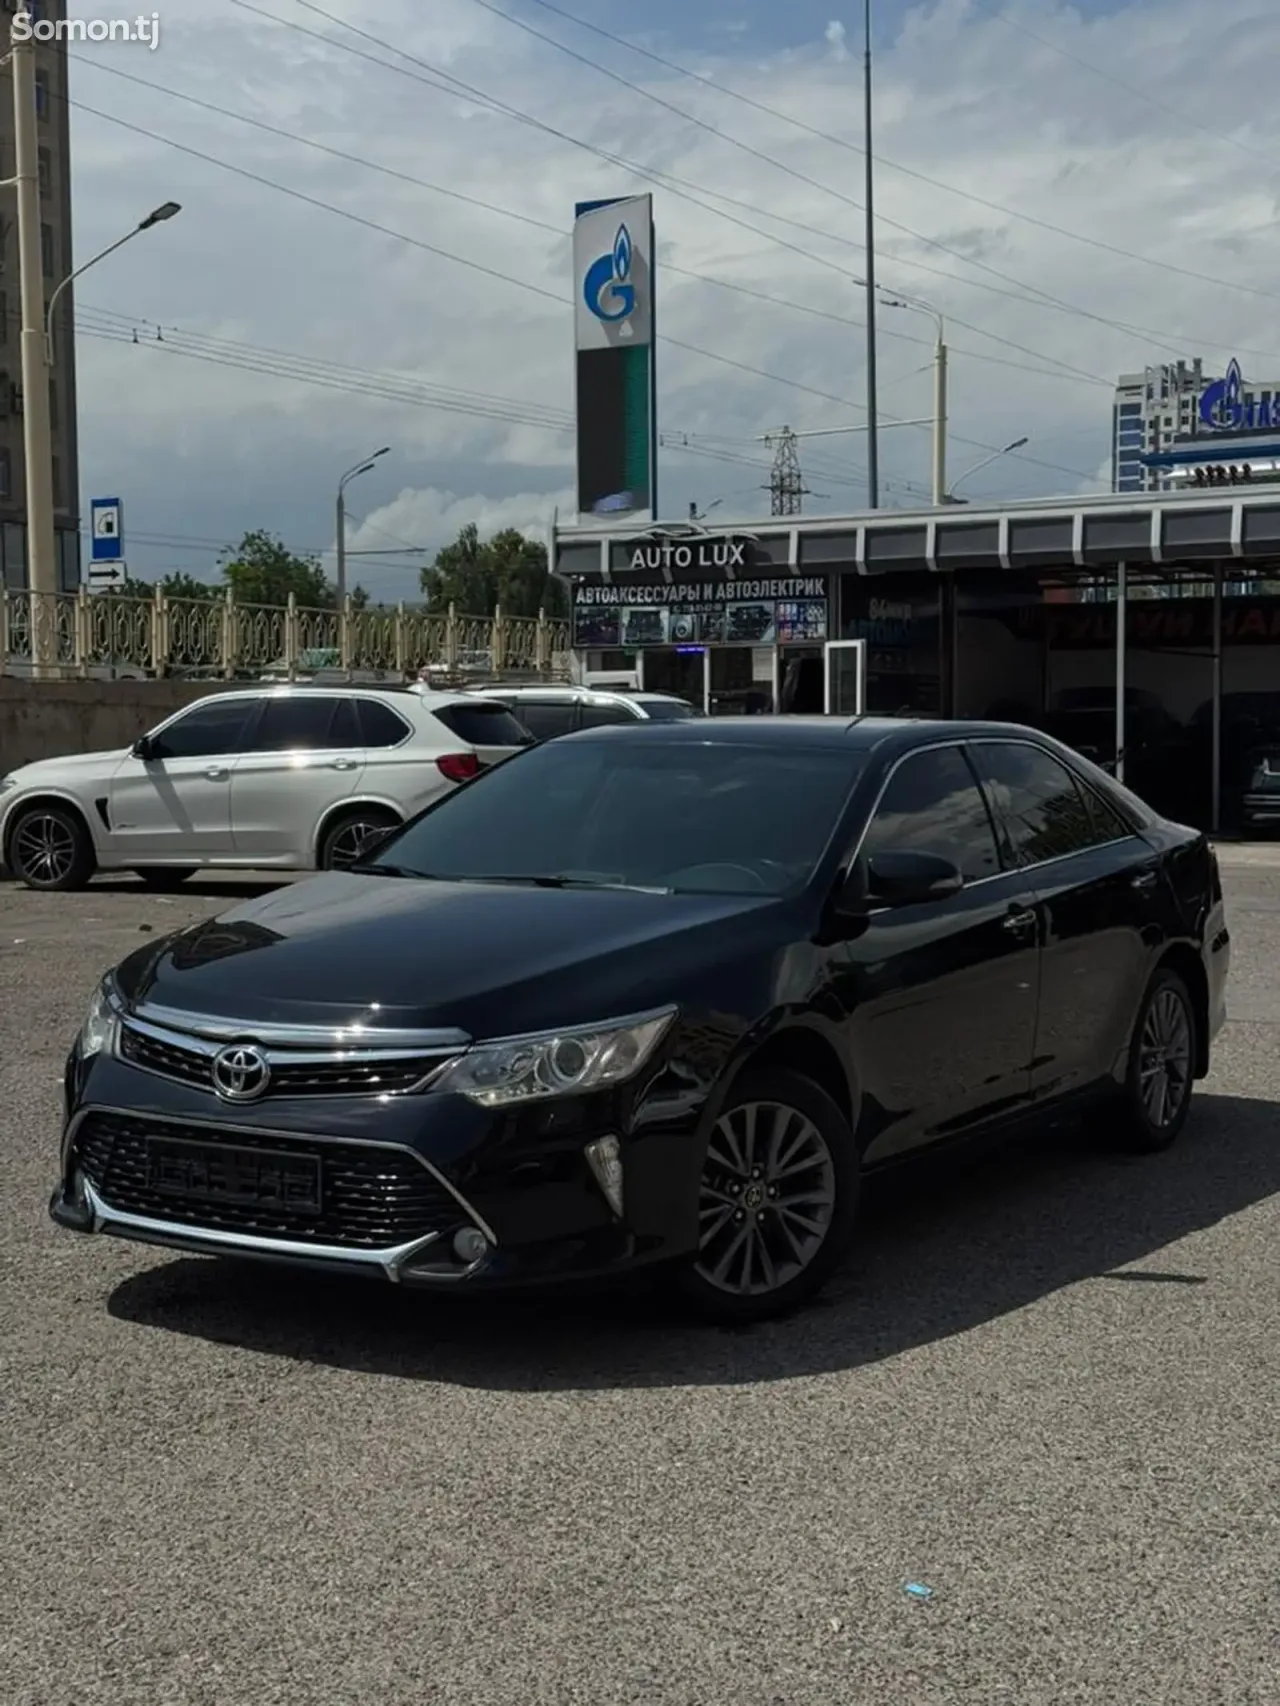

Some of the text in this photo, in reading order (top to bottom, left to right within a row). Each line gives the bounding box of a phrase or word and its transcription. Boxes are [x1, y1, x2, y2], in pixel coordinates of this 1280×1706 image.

[631, 544, 746, 569] AUTO LUX
[576, 578, 825, 605] АВТОАКСЕССУАРЫ И АВТОЭЛЕКТРИК
